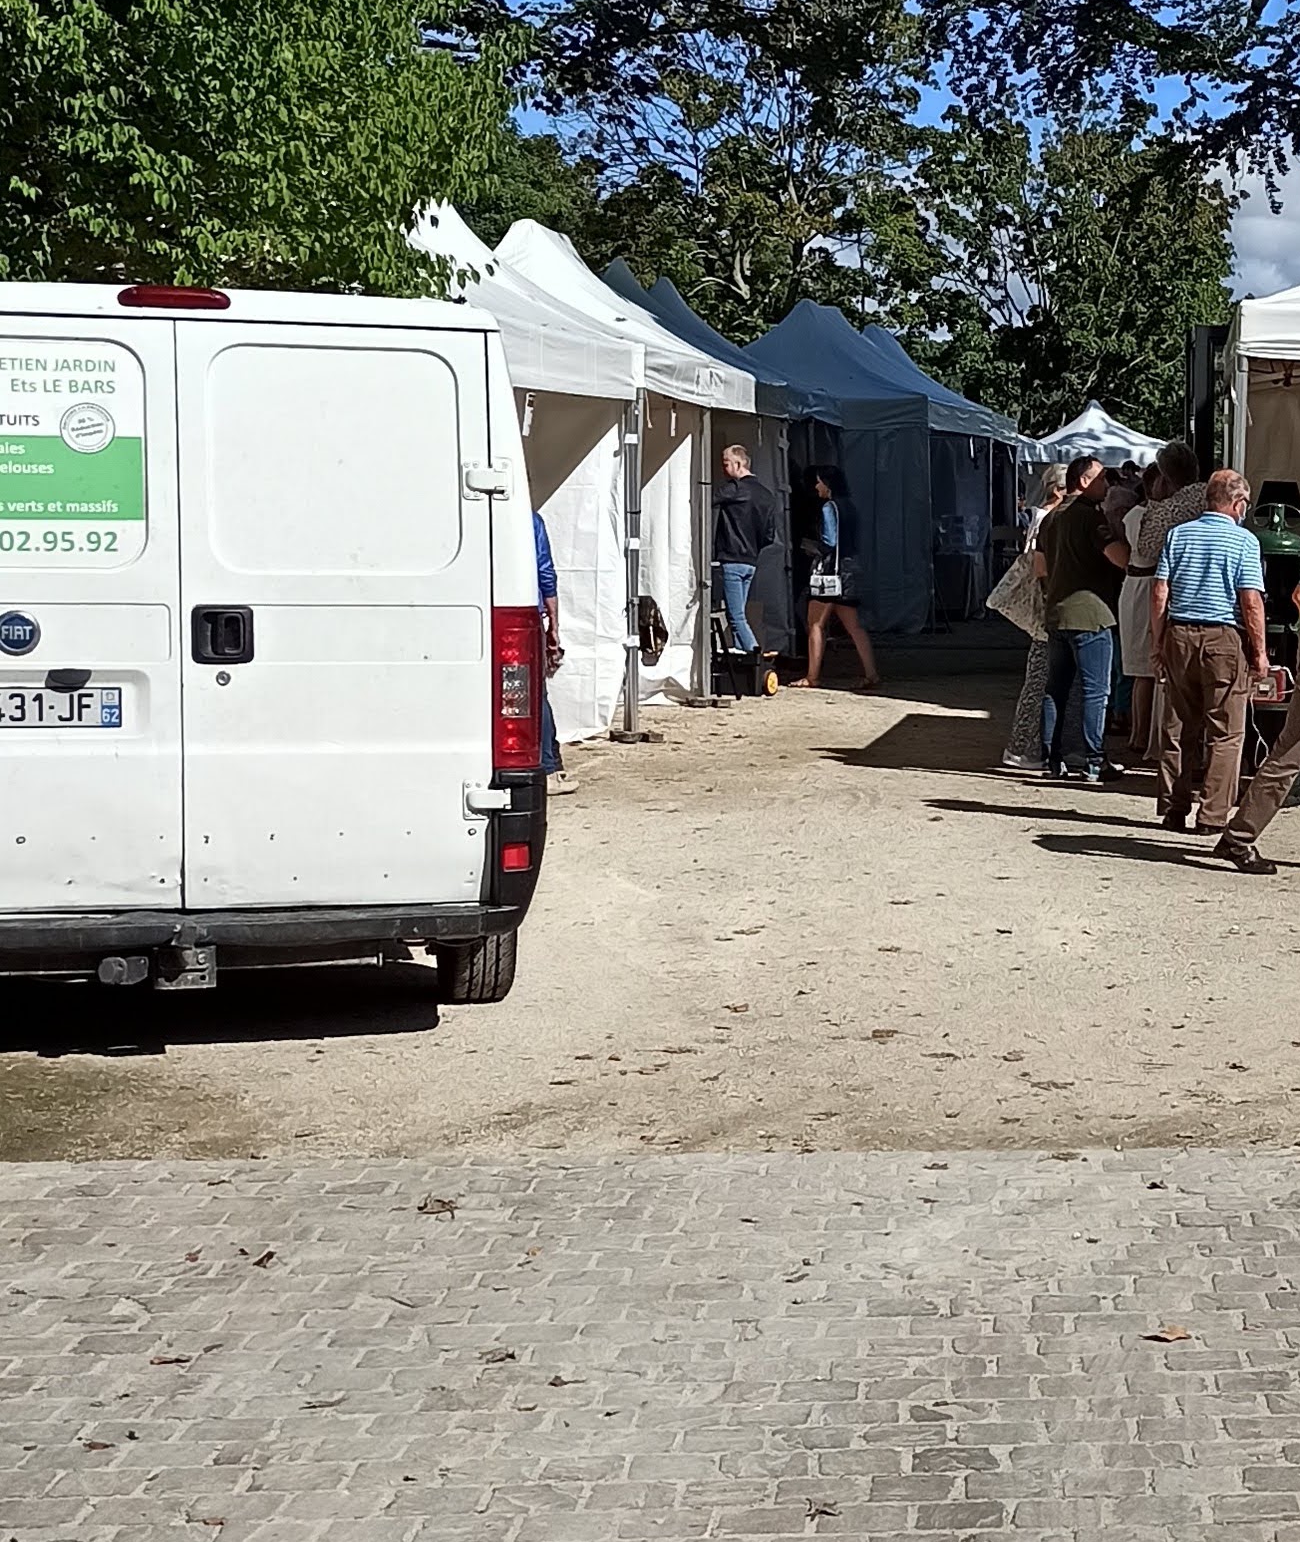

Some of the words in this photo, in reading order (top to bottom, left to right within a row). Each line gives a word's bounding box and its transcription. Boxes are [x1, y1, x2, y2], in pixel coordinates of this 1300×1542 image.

[0, 357, 47, 371] ETIEN
[53, 358, 116, 372] JARDIN
[10, 378, 37, 393] Ets
[43, 378, 62, 393] LE
[68, 379, 116, 394] BARS
[0, 460, 55, 474] elouses
[7, 500, 45, 512] verts
[48, 500, 63, 512] et
[66, 499, 119, 513] massifs
[0, 530, 119, 552] 02.95.92
[1, 625, 33, 640] FIAT
[0, 692, 95, 722] 31-JF
[102, 708, 120, 723] 62
